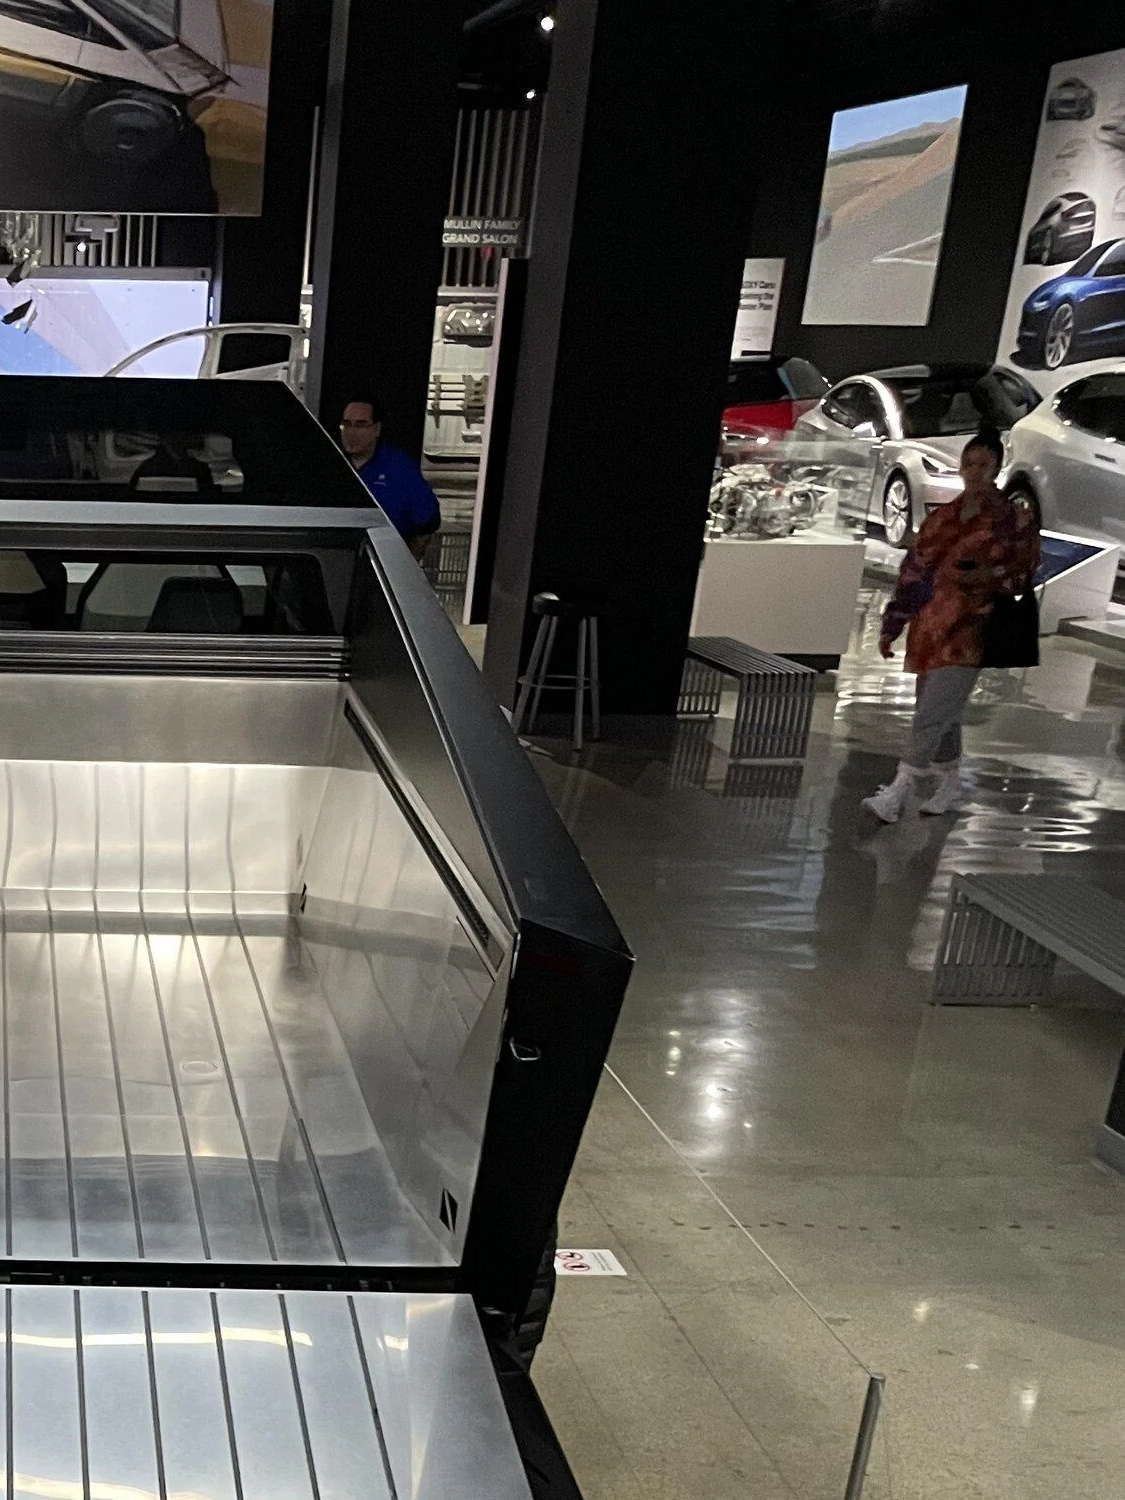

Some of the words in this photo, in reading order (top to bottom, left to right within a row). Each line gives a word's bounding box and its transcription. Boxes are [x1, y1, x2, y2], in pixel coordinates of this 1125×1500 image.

[444, 219, 482, 230] MULLIN
[484, 219, 521, 230] FAMILY
[442, 232, 481, 244] GRAND
[482, 233, 519, 244] SALON
